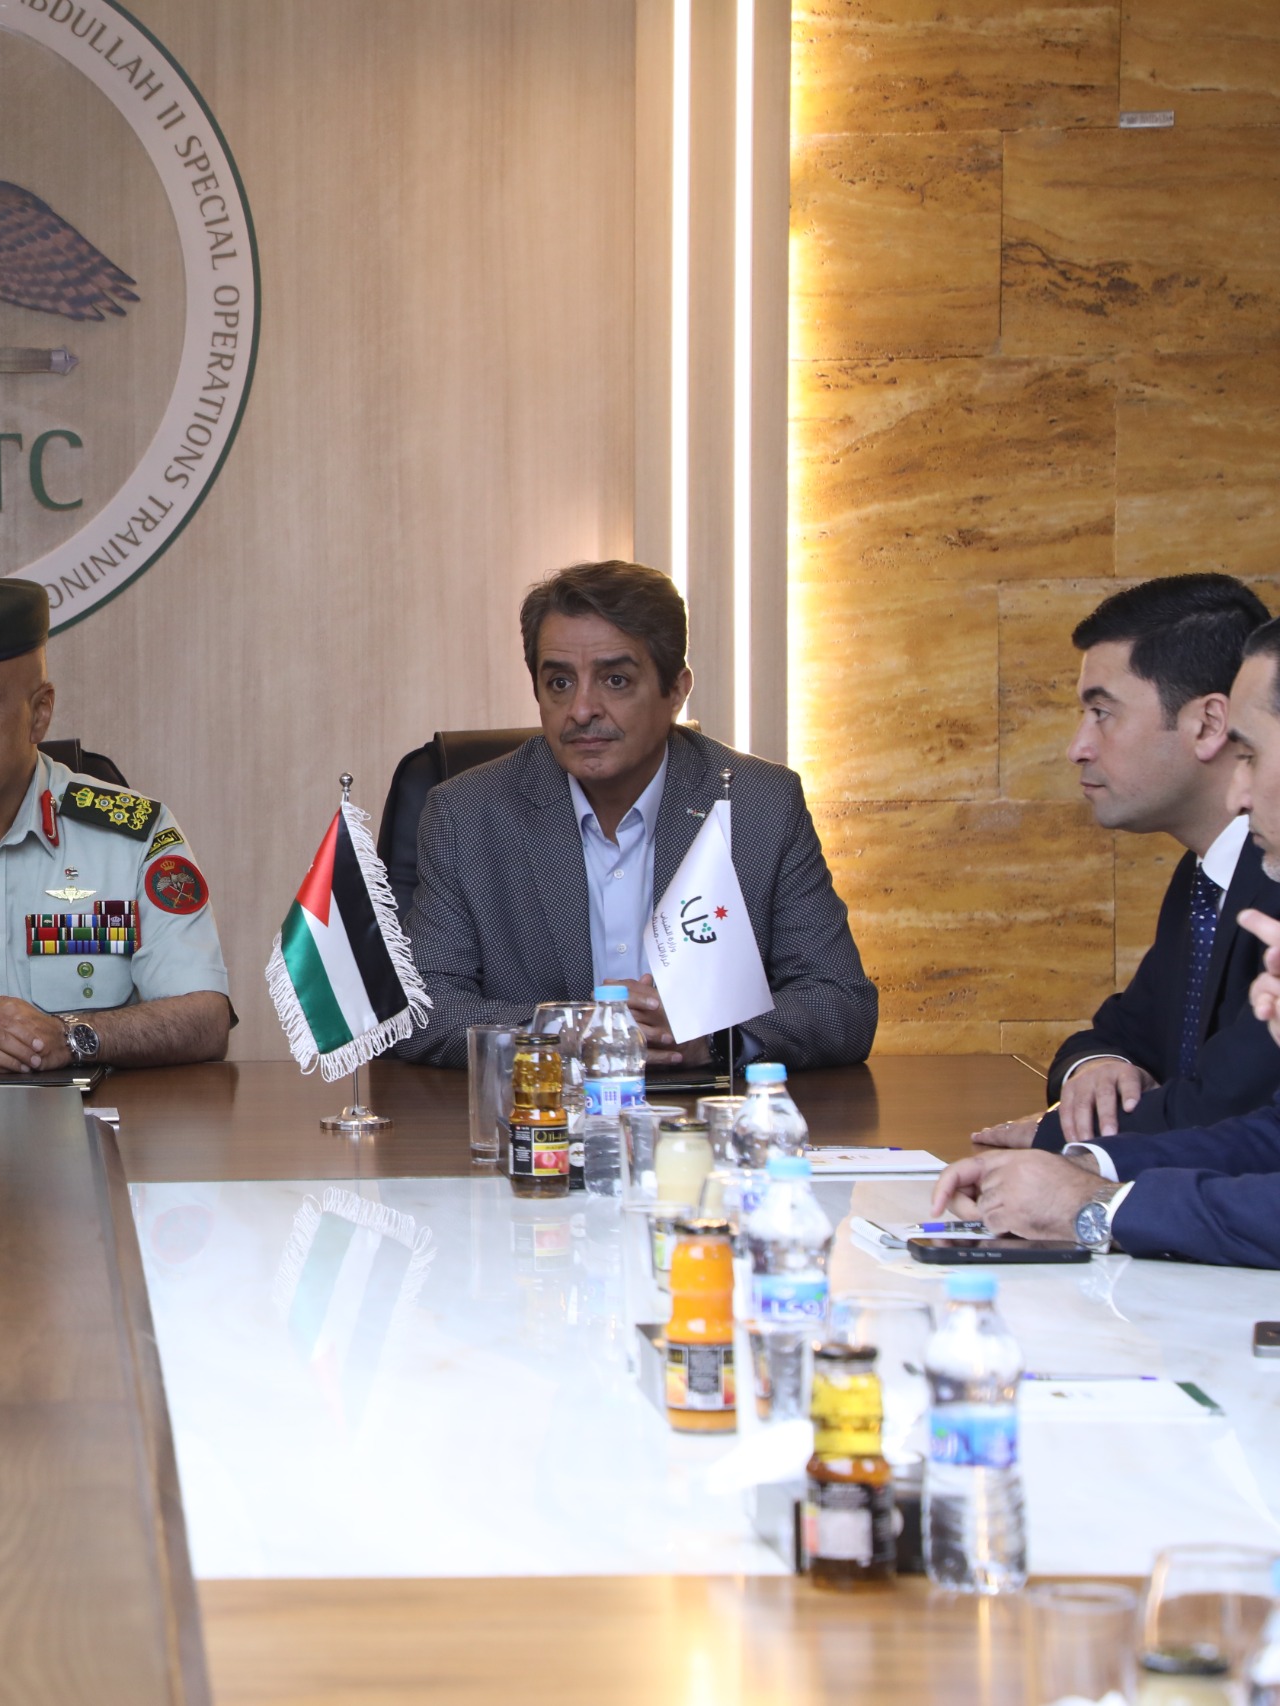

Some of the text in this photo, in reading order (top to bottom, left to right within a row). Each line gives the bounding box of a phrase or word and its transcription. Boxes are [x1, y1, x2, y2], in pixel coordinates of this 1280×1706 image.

[174, 135, 237, 271] SPECIAL
[164, 284, 241, 489] OPERATIONS
[660, 911, 677, 953] وزارة الشباب
